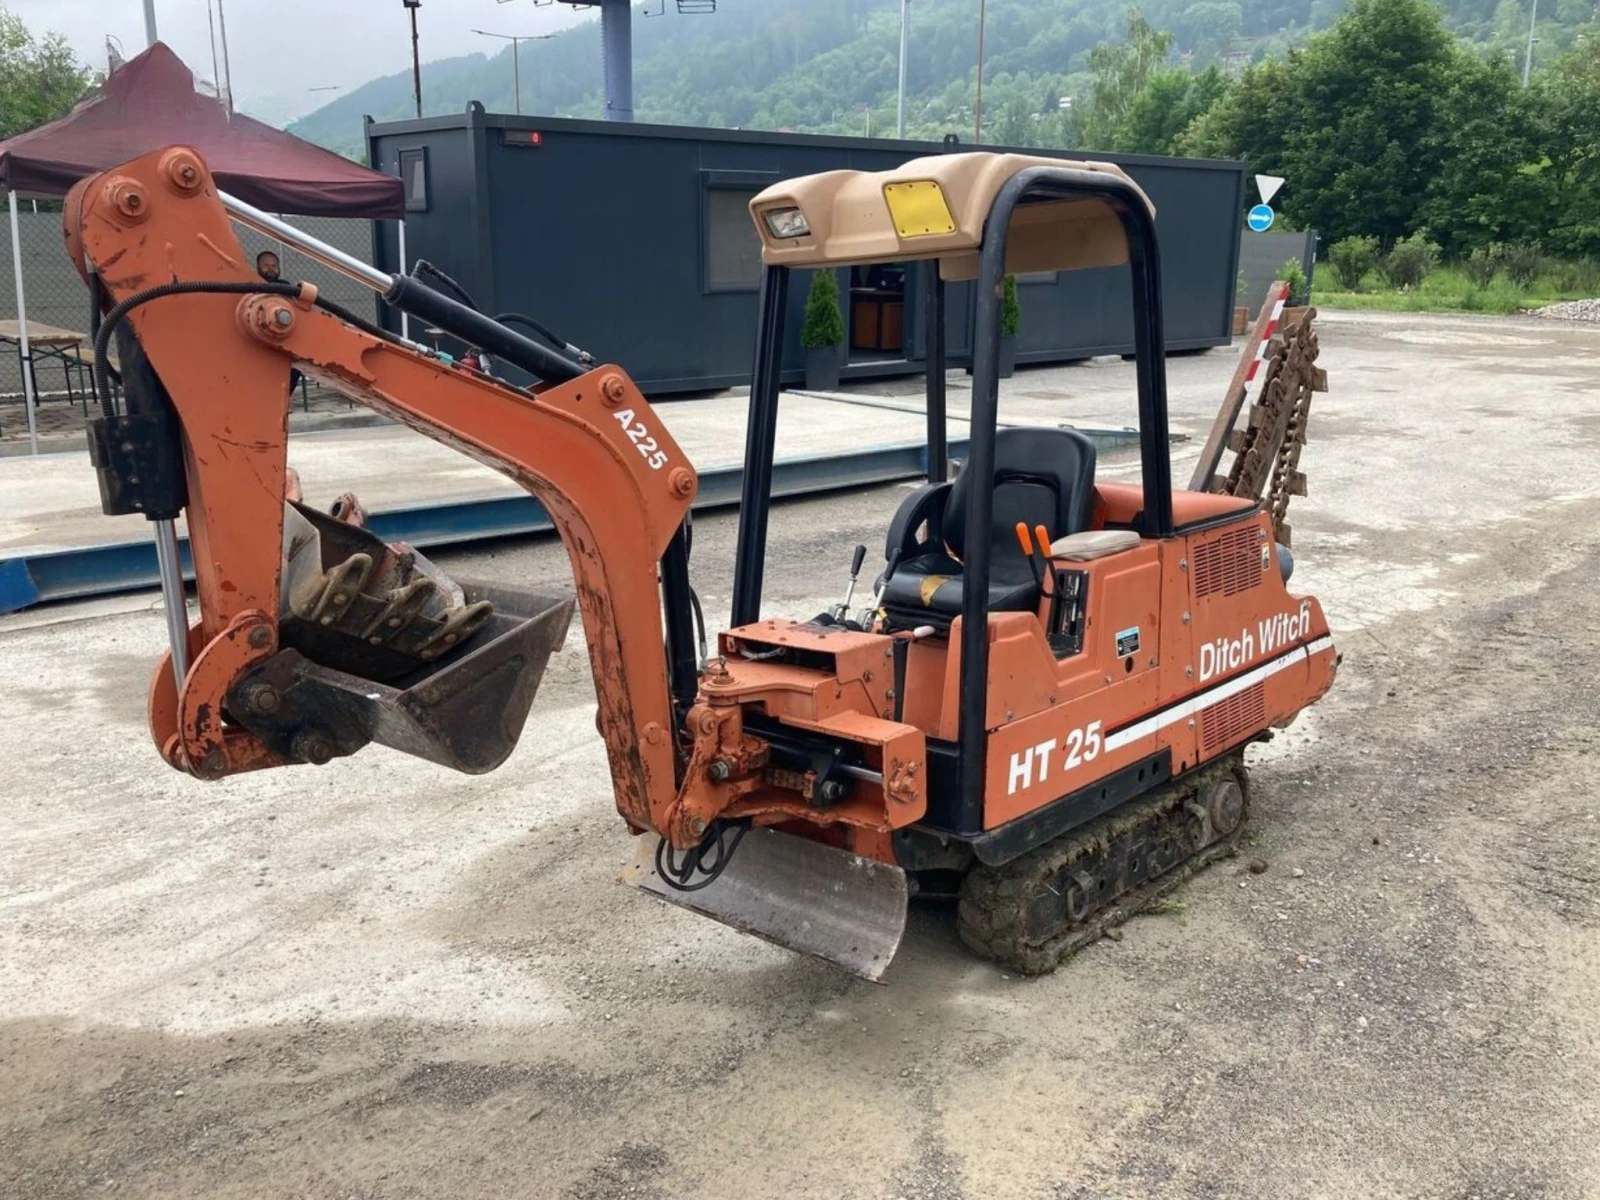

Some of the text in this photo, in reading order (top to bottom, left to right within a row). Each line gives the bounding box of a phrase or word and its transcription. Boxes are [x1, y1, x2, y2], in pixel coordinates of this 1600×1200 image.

[612, 409, 669, 470] A225
[1199, 628, 1254, 683] Ditch
[1258, 600, 1310, 655] Witch
[1007, 719, 1102, 796] HT 25
